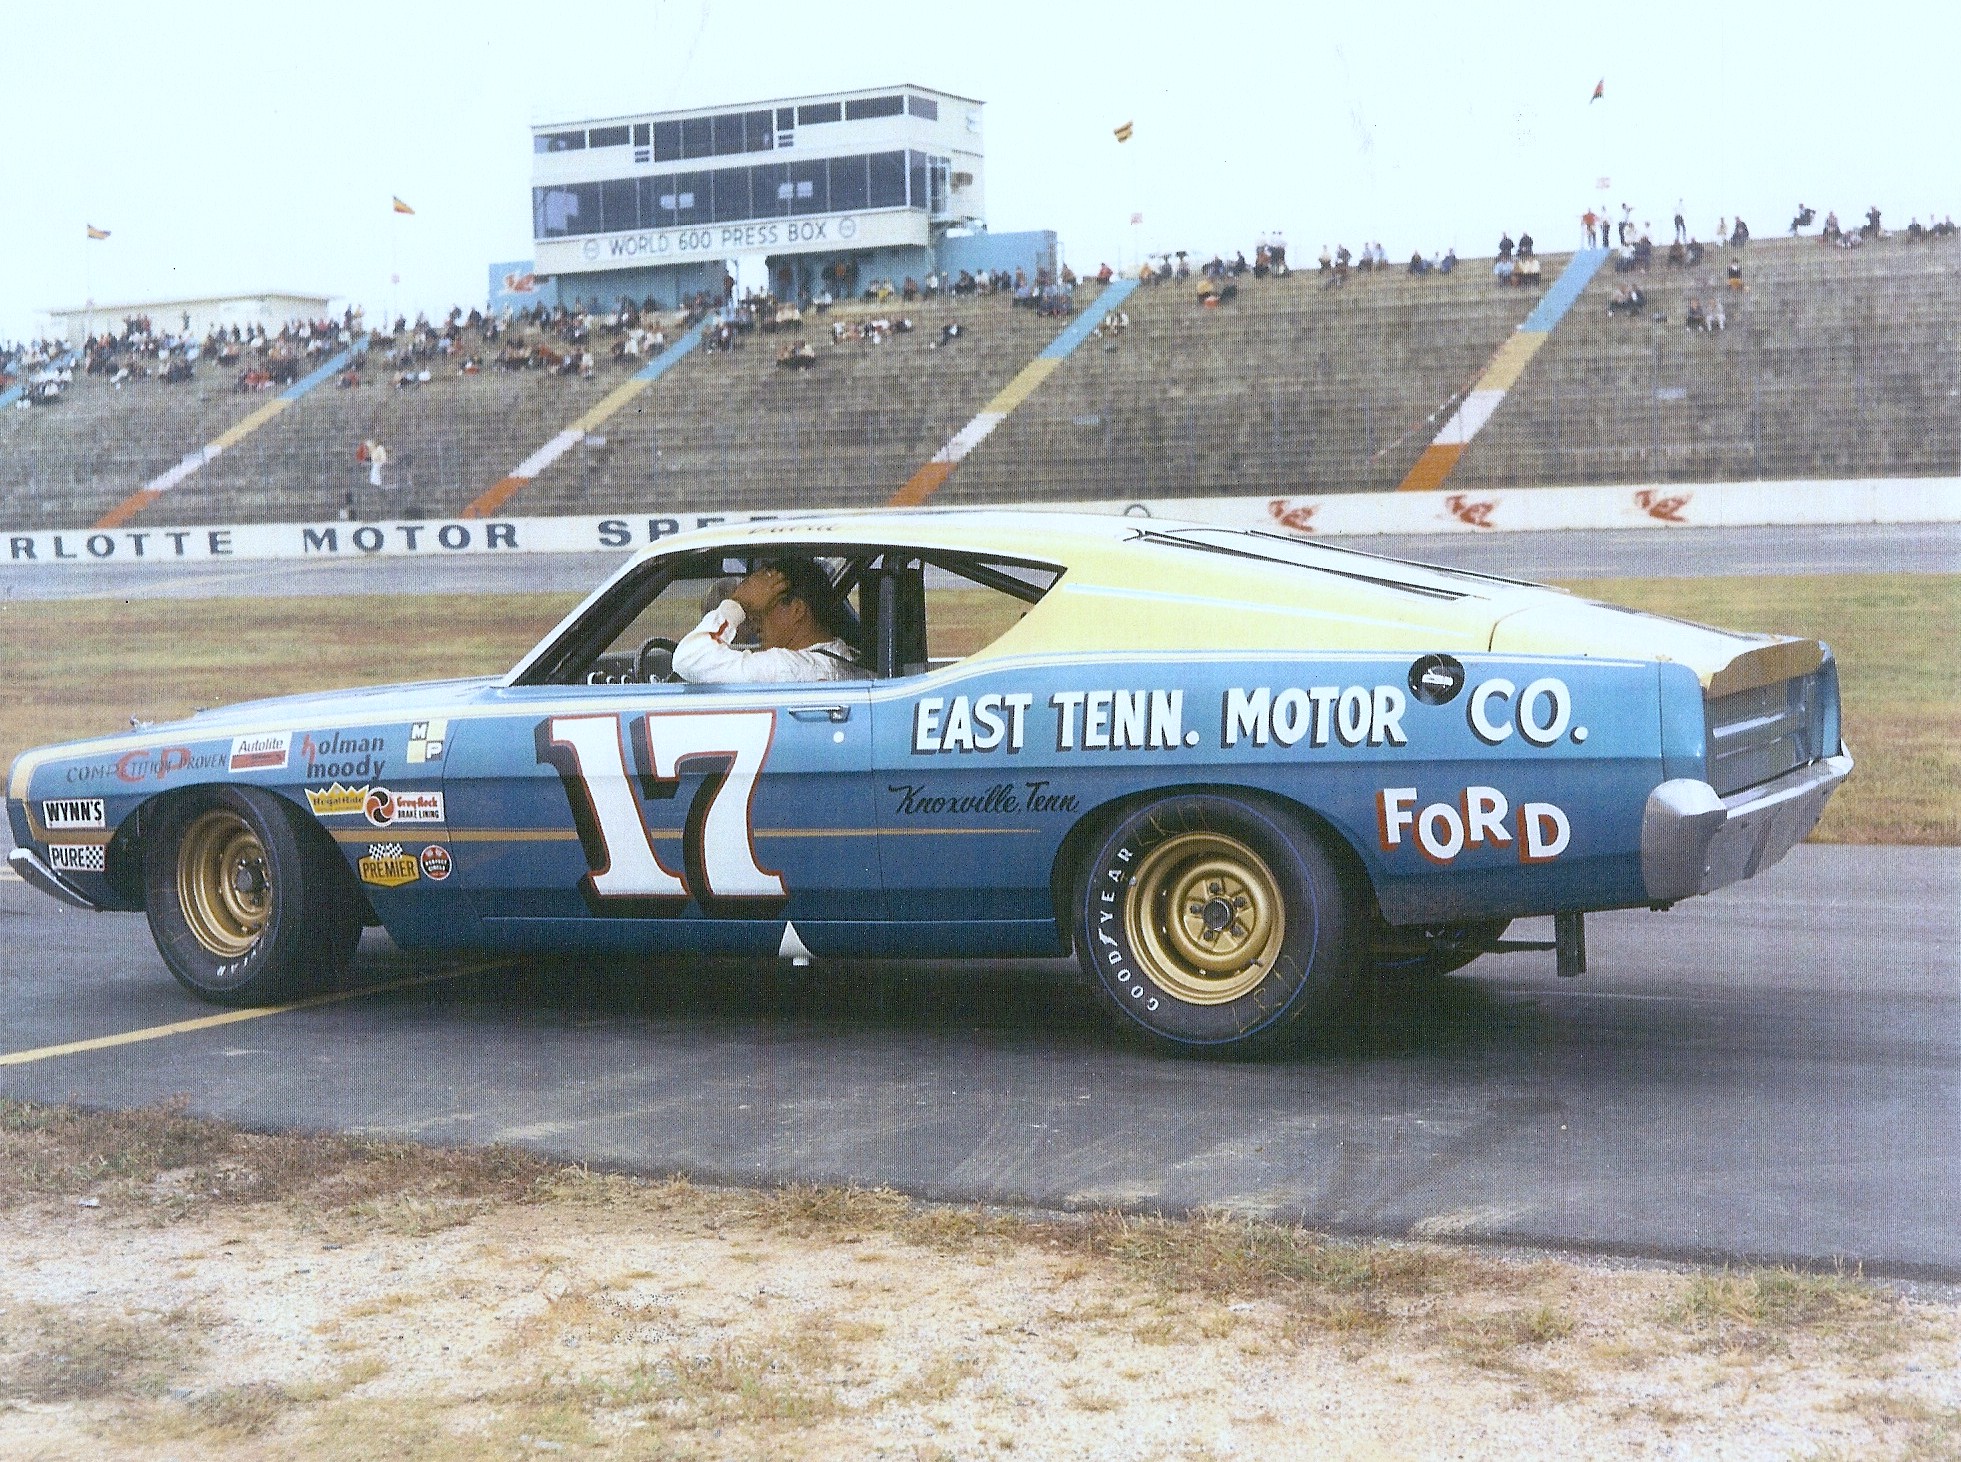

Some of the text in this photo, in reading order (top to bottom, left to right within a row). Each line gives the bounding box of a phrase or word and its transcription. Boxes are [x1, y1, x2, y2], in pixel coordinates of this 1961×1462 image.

[609, 233, 668, 256] WORLD
[678, 229, 712, 251] 600
[722, 224, 778, 249] PRESS
[787, 220, 828, 242] BOX
[302, 522, 520, 554] MOTOR
[912, 677, 1589, 754] EAST TENN. MOTOR CO.
[238, 738, 284, 754] Autolite
[302, 731, 385, 764] holman
[306, 754, 385, 780] moody
[45, 801, 102, 822] WYNN'S
[540, 708, 791, 910] 17
[888, 785, 1021, 814] Knoxville,
[1379, 786, 1571, 863] FORD
[51, 846, 85, 867] PURE
[362, 860, 416, 879] PREMIER
[1098, 847, 1160, 1012] GOODYEAR
